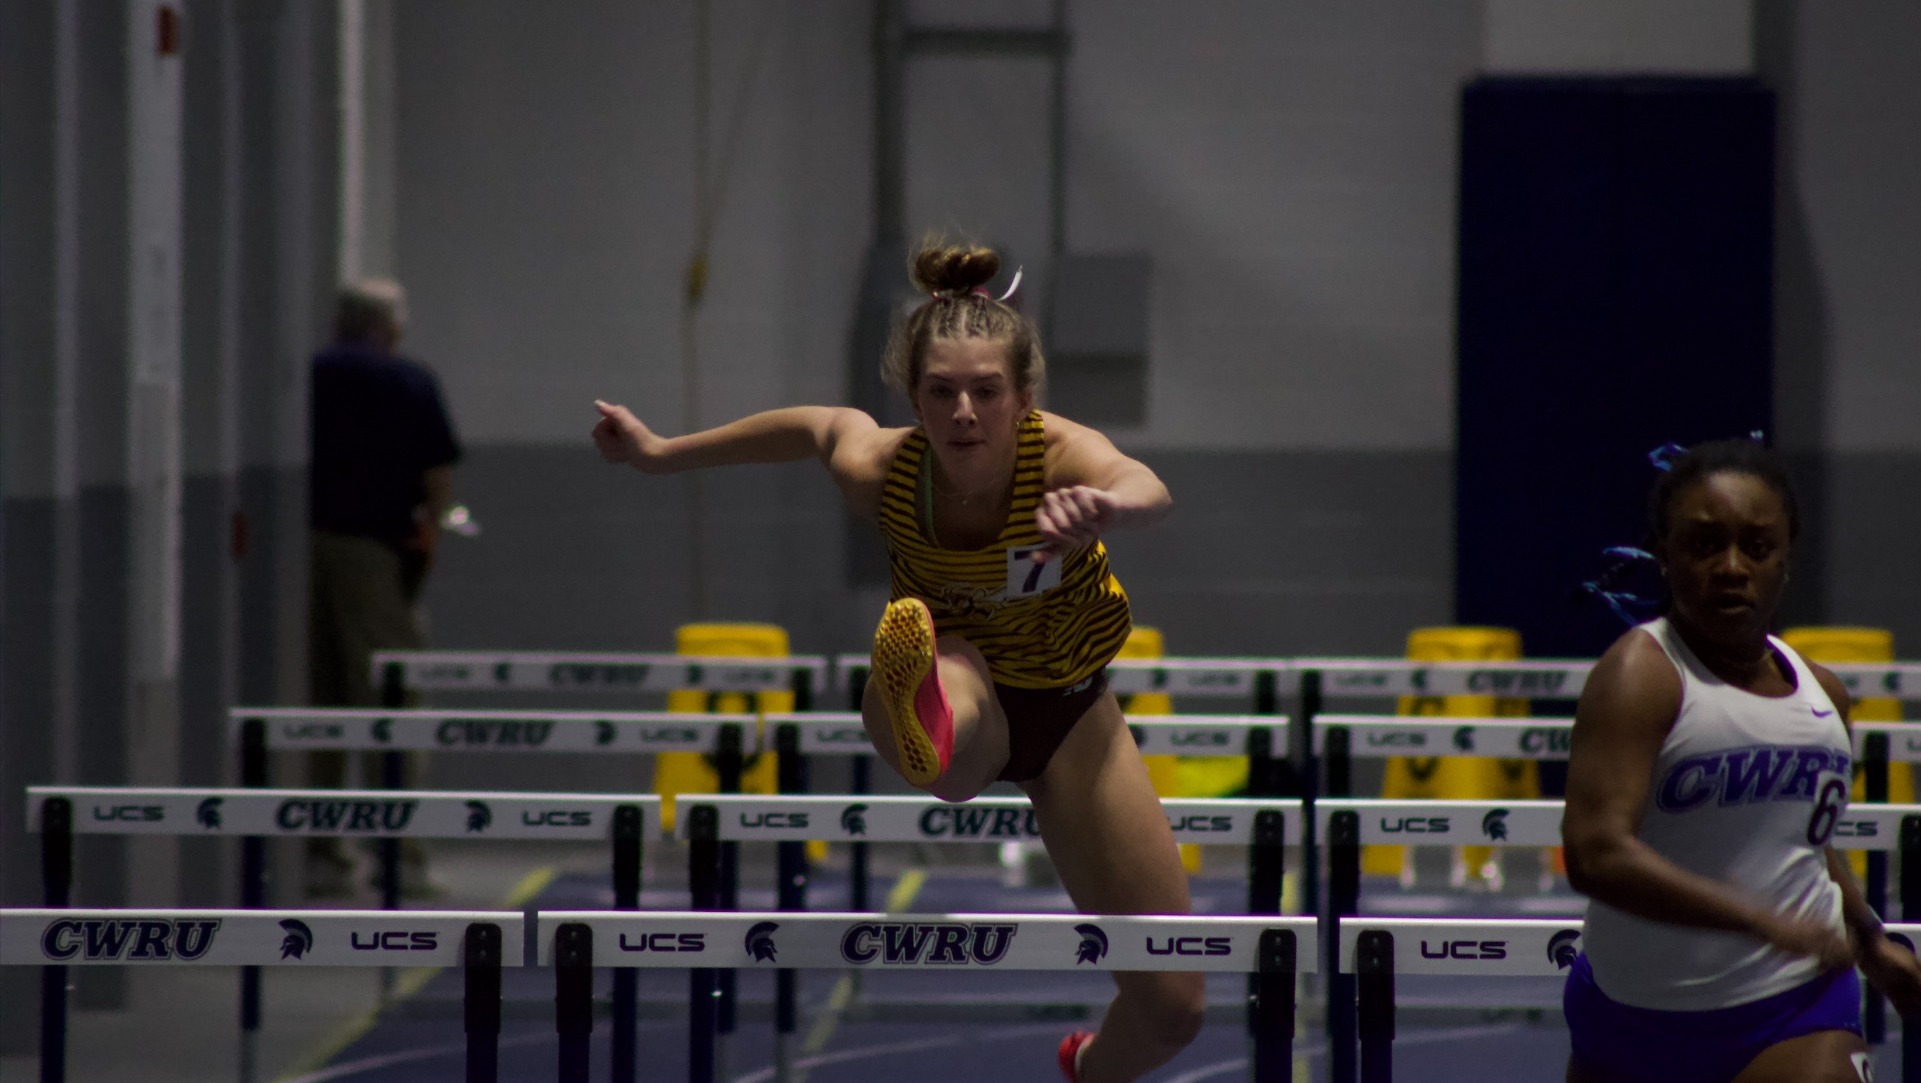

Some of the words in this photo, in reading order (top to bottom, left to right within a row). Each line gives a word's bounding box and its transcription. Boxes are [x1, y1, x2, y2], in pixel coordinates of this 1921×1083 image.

[1014, 550, 1046, 593] 7
[1656, 745, 1850, 814] CWR
[93, 805, 164, 822] UCS
[276, 799, 419, 831] CWRU
[522, 810, 592, 827] UCS
[740, 811, 809, 828] UCS
[1381, 817, 1450, 833] UCS
[1807, 779, 1846, 846] 6
[41, 917, 221, 960] CWRU
[351, 931, 438, 950] UCS
[619, 932, 705, 951] UCS
[841, 921, 1018, 965] CWRU
[1146, 936, 1232, 956] UCS
[1420, 940, 1507, 960] UCS
